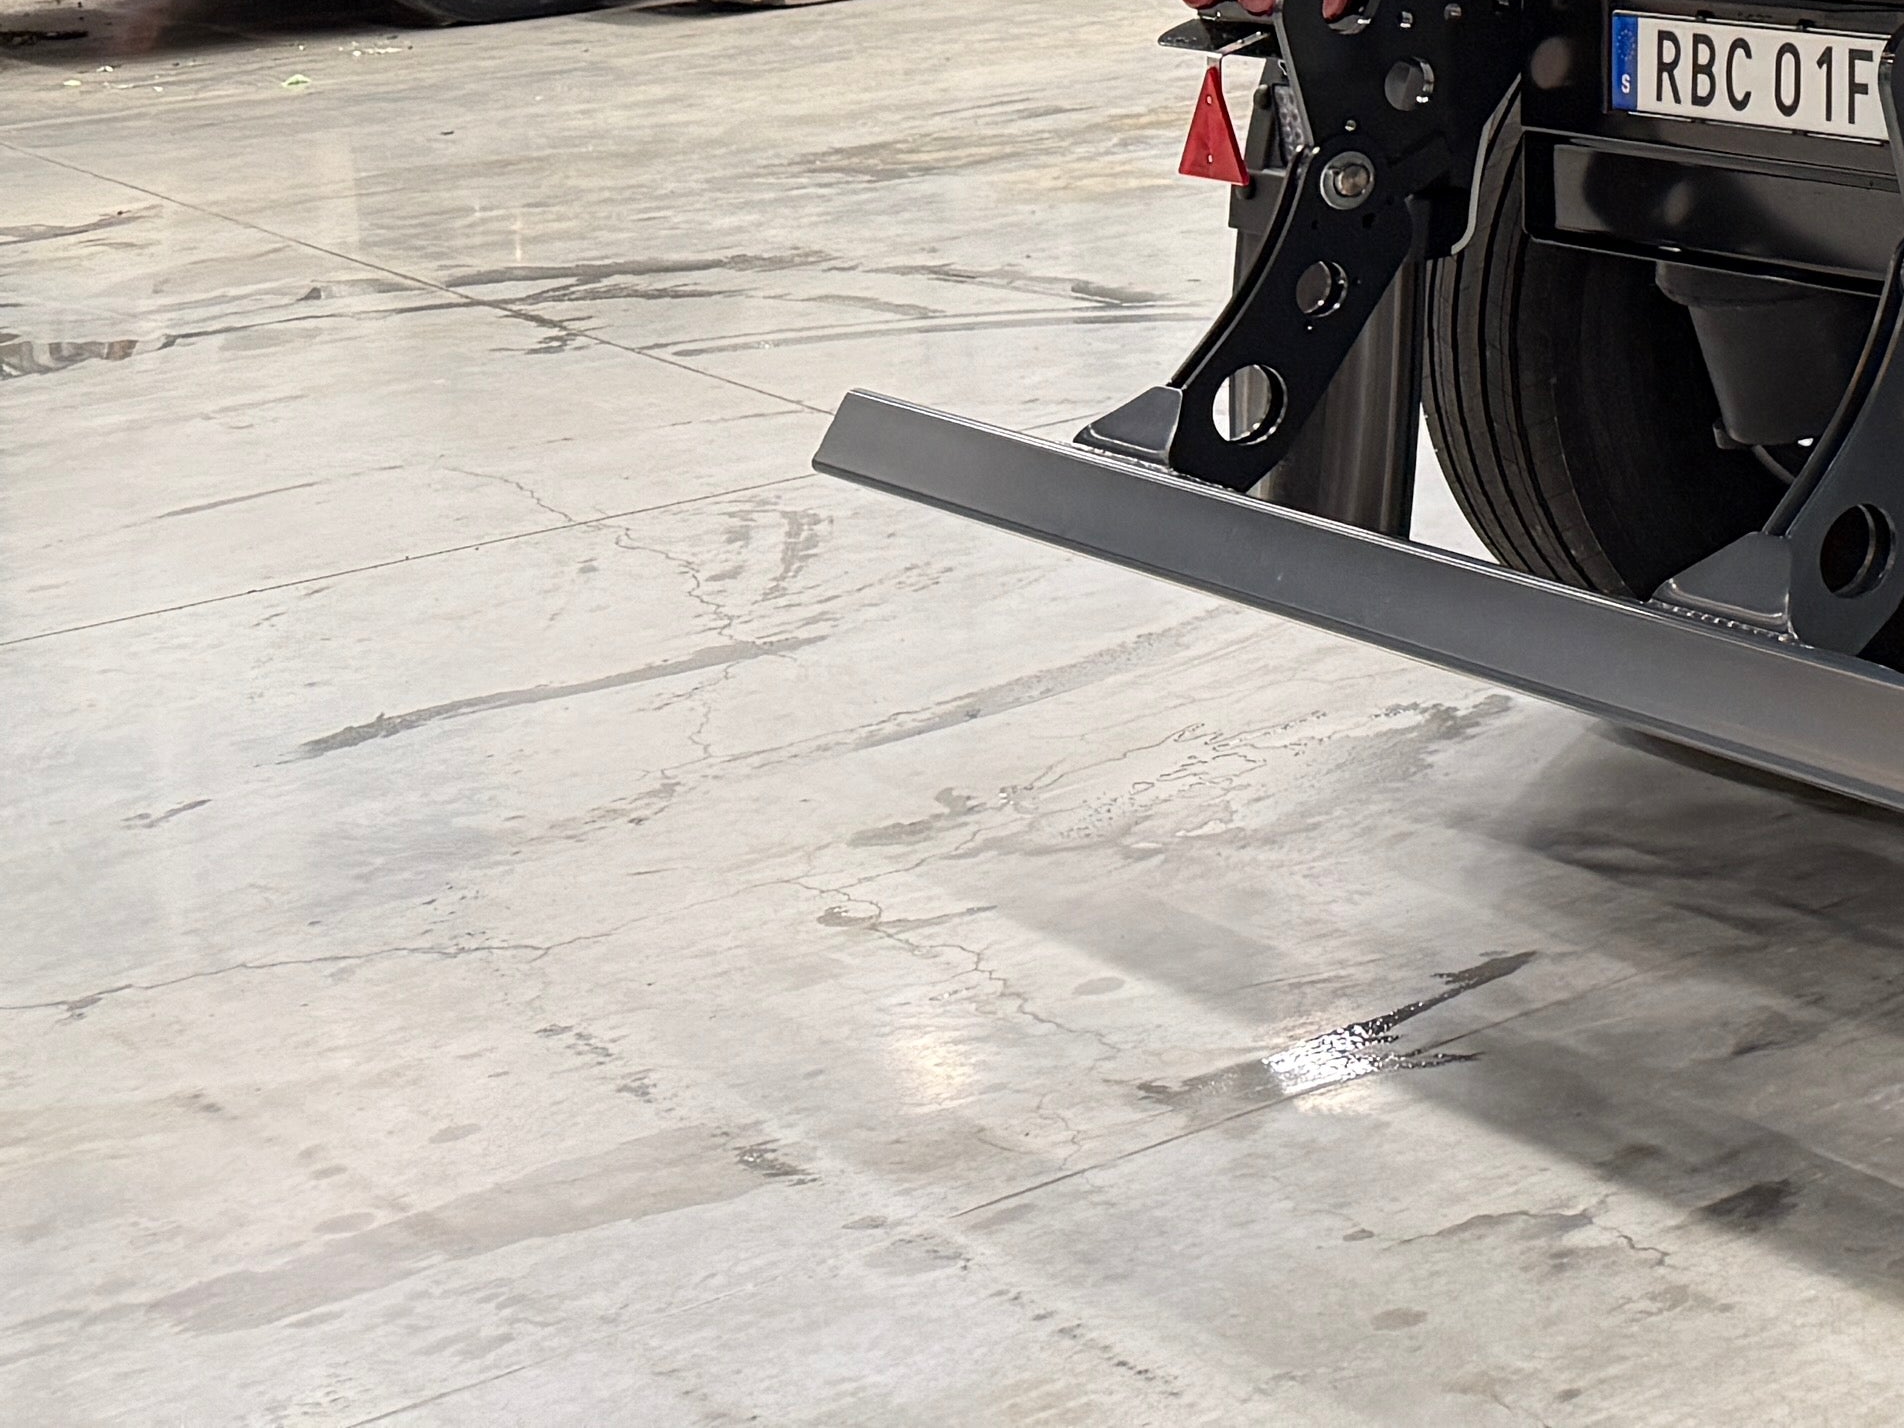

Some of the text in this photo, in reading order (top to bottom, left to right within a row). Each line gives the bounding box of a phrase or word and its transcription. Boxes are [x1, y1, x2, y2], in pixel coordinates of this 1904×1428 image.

[1621, 73, 1631, 94] S
[1656, 29, 1874, 125] RBC 01F
